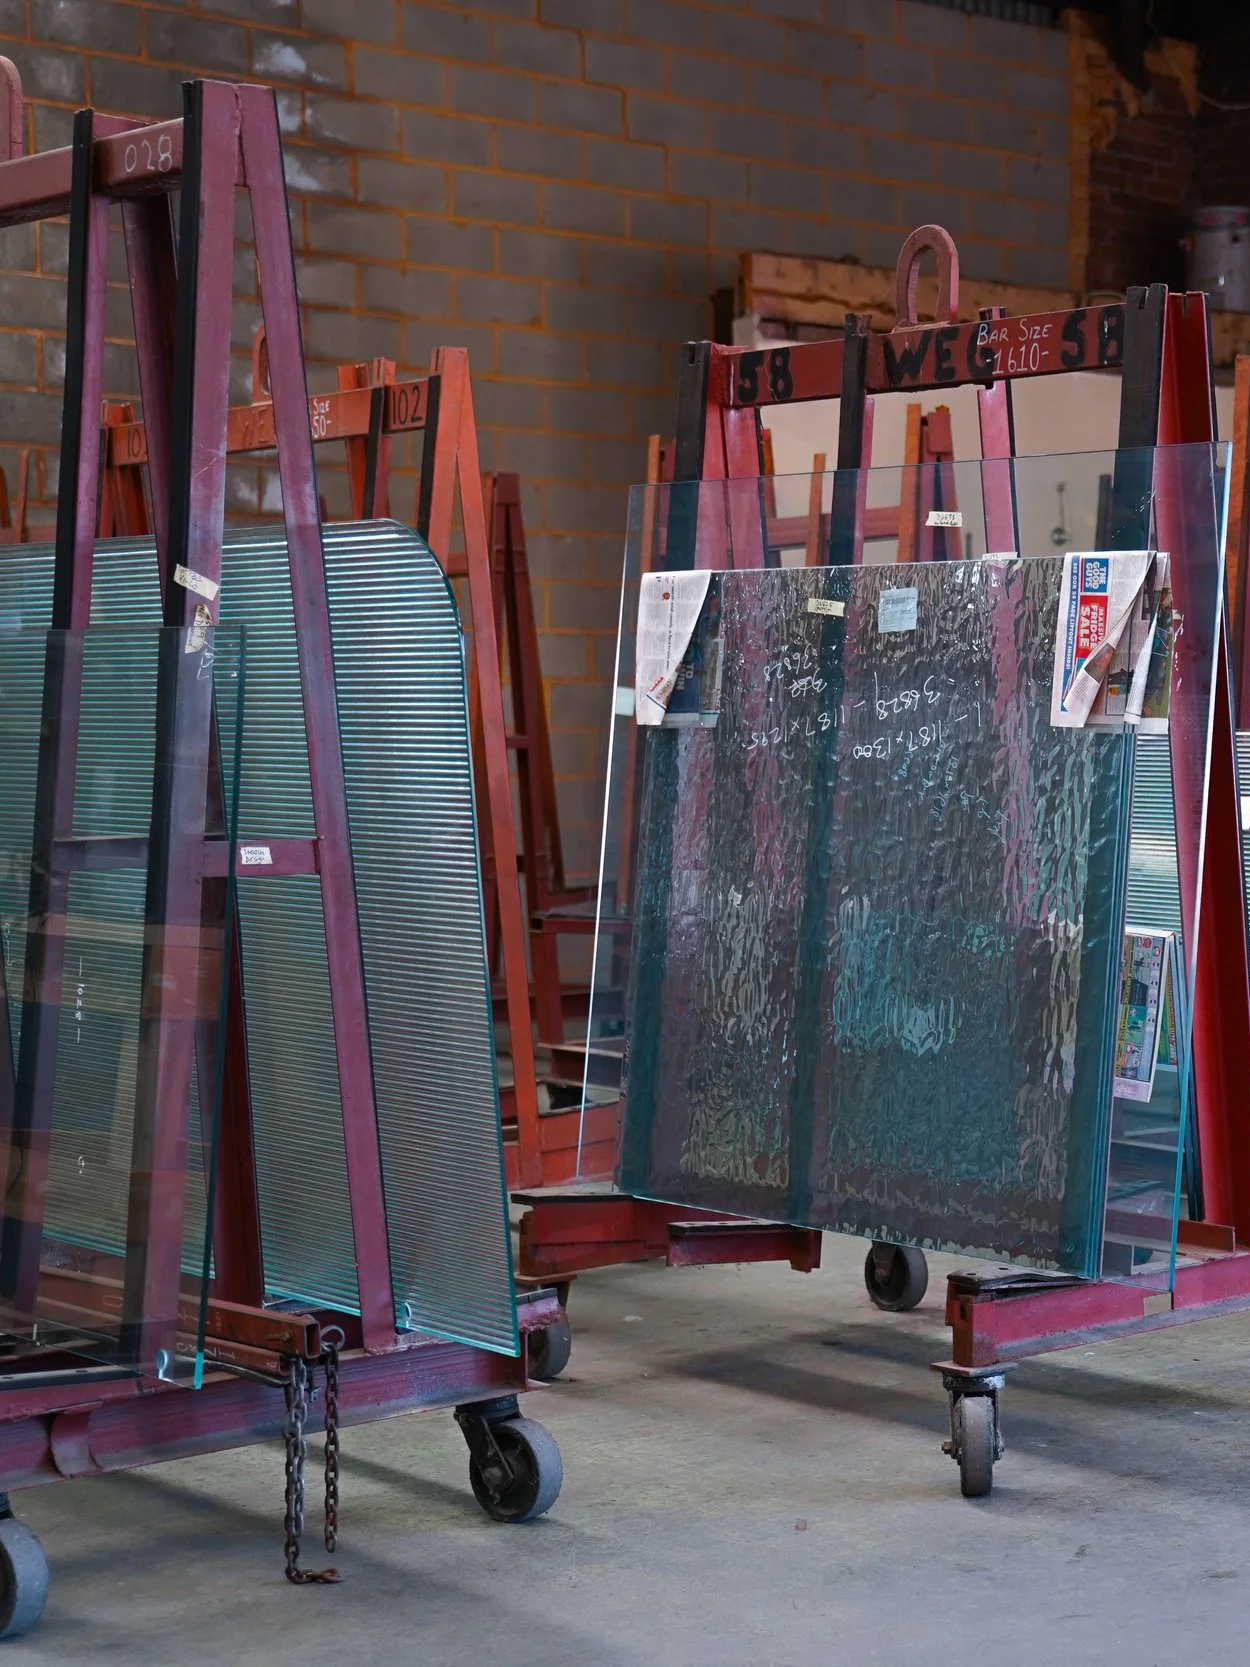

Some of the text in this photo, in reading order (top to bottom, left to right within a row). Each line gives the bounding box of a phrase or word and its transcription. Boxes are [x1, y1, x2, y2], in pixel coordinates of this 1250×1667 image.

[124, 134, 172, 173] 028
[737, 346, 794, 404] 58
[392, 384, 423, 425] 102
[1085, 562, 1093, 589] GUYS
[1091, 561, 1100, 590] GOOD
[1099, 566, 1107, 585] THE
[1080, 605, 1091, 649] SALE
[1090, 604, 1099, 651] FRIDGE
[685, 662, 694, 679] TO
